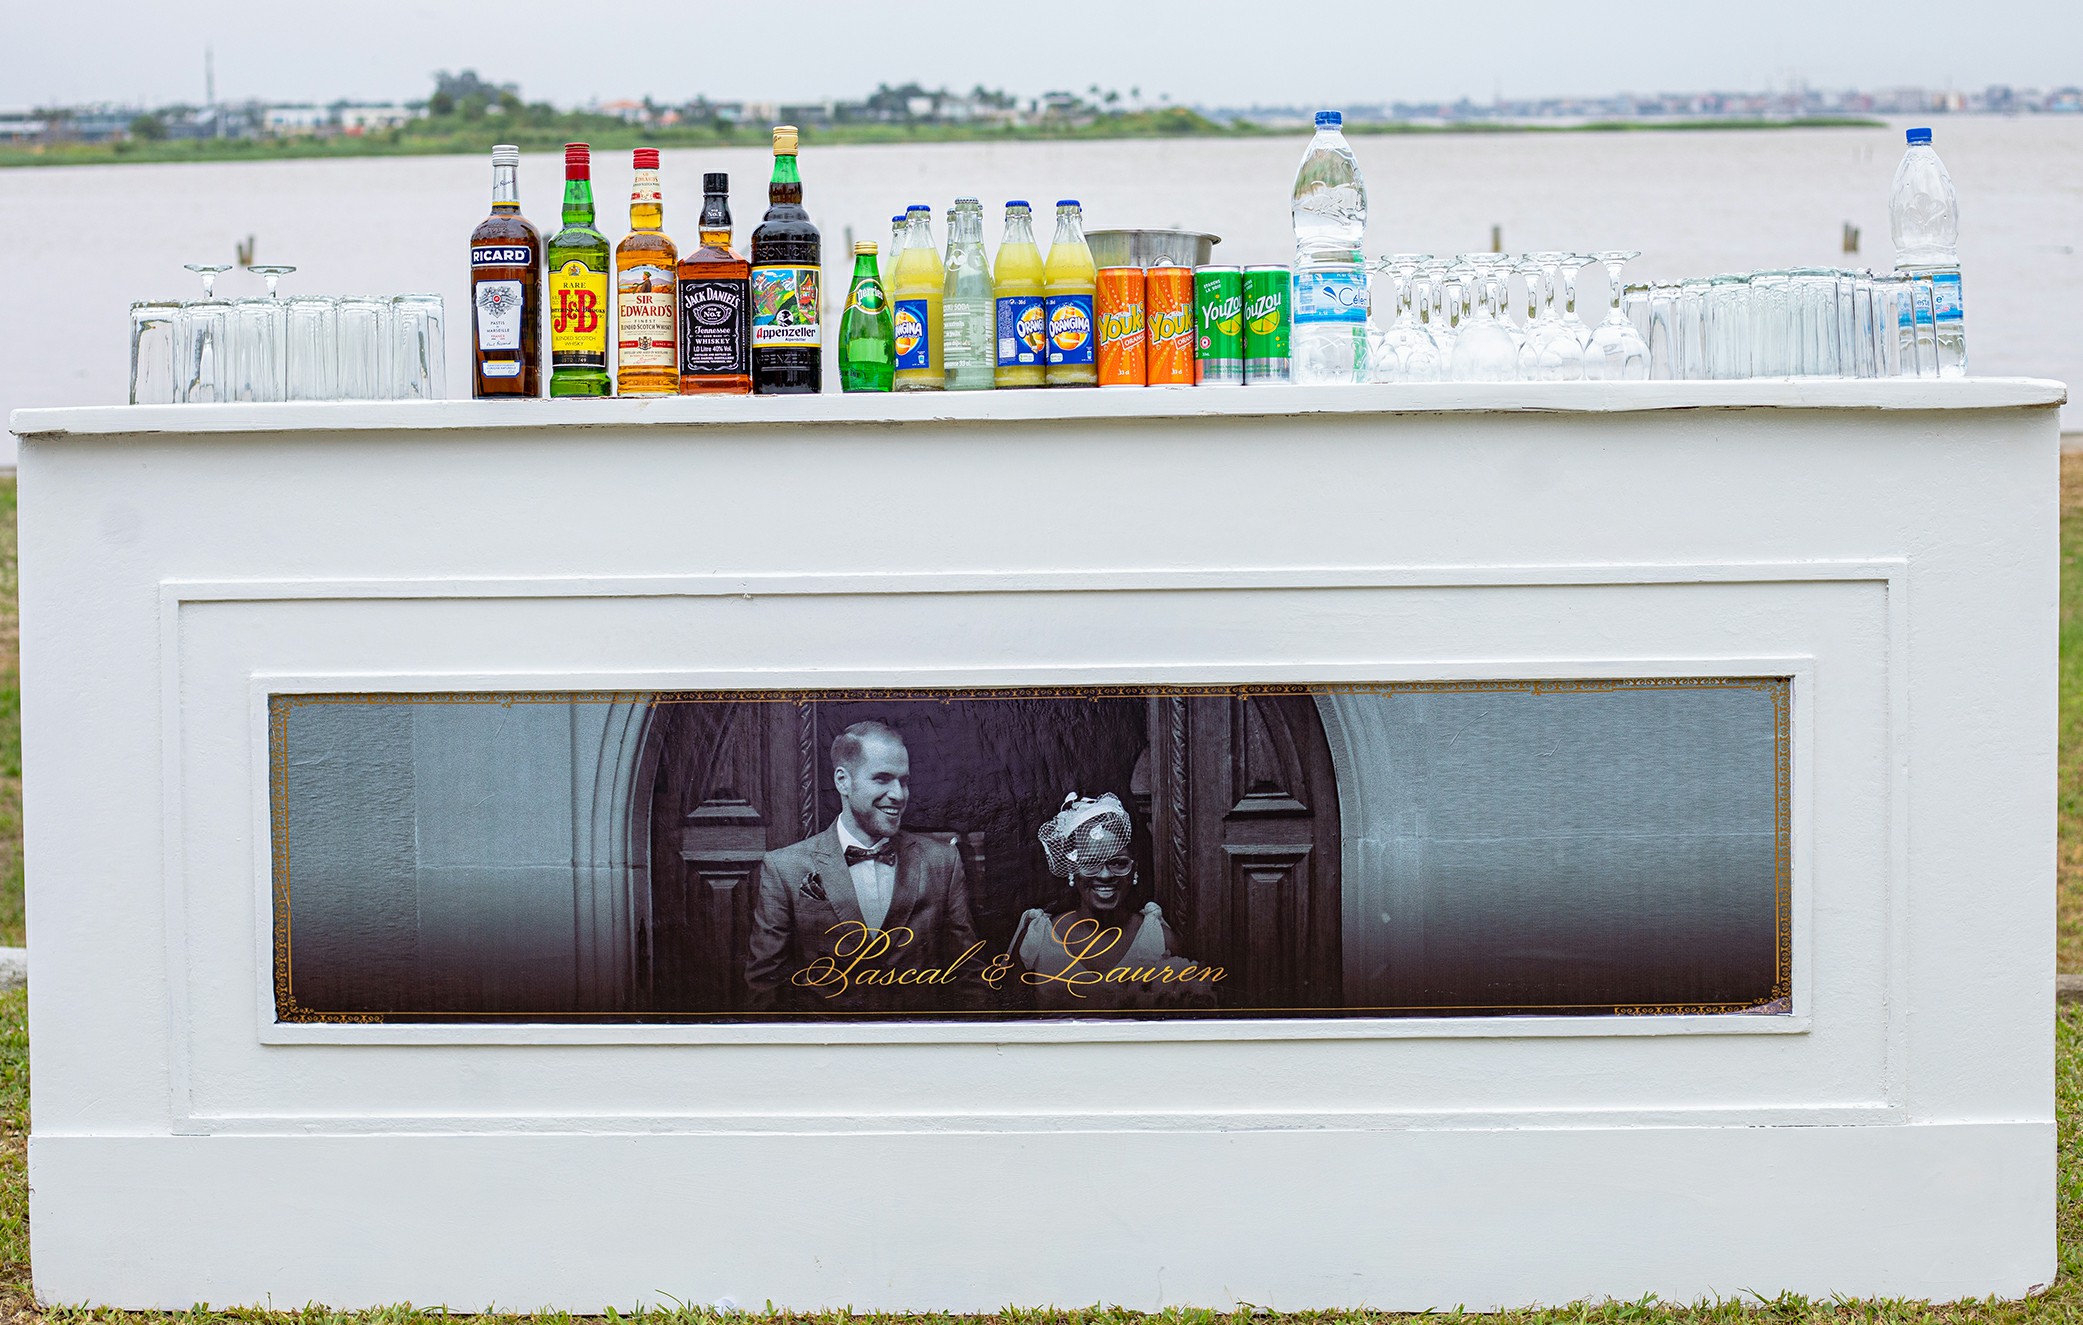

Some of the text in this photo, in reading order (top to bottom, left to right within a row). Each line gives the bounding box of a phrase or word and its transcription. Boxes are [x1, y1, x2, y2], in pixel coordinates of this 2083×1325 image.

[473, 250, 525, 262] RICARD
[636, 295, 653, 304] SIR
[685, 287, 740, 309] JACK DANIEL'S
[554, 289, 598, 333] J&B
[620, 305, 672, 317] EDWARD'S
[694, 325, 731, 334] Tennessee
[756, 327, 816, 339] Appenzeller
[1016, 319, 1045, 338] ORANG
[1049, 317, 1090, 339] ORANGINA
[791, 910, 1228, 999] Pascal & Lauren
